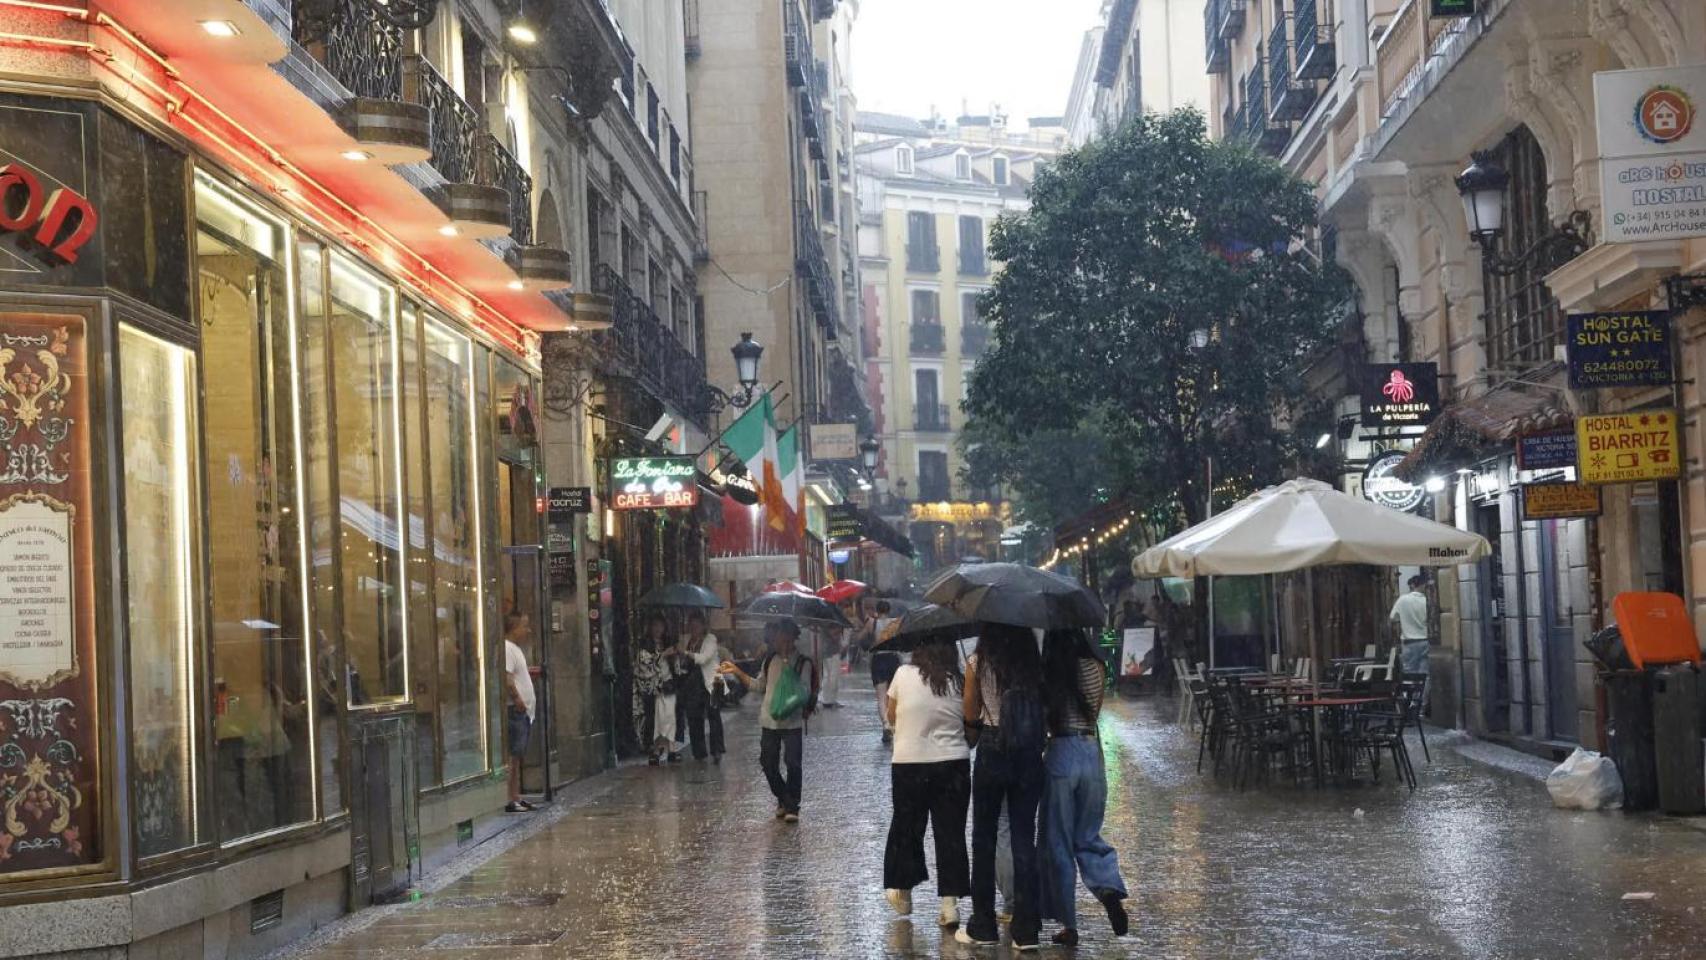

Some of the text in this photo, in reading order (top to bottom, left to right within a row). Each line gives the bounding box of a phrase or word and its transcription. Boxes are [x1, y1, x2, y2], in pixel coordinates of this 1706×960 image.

[1632, 186, 1706, 206] HOSTAL
[1583, 316, 1653, 331] HOSTAL
[1575, 329, 1664, 346] SUN GATE
[1370, 405, 1382, 413] LA
[1585, 416, 1634, 432] HOSTAL
[1588, 431, 1670, 451] BIARRITZ
[614, 459, 696, 478] La Fontana
[624, 478, 646, 493] de
[617, 492, 692, 507] CAFE BAR
